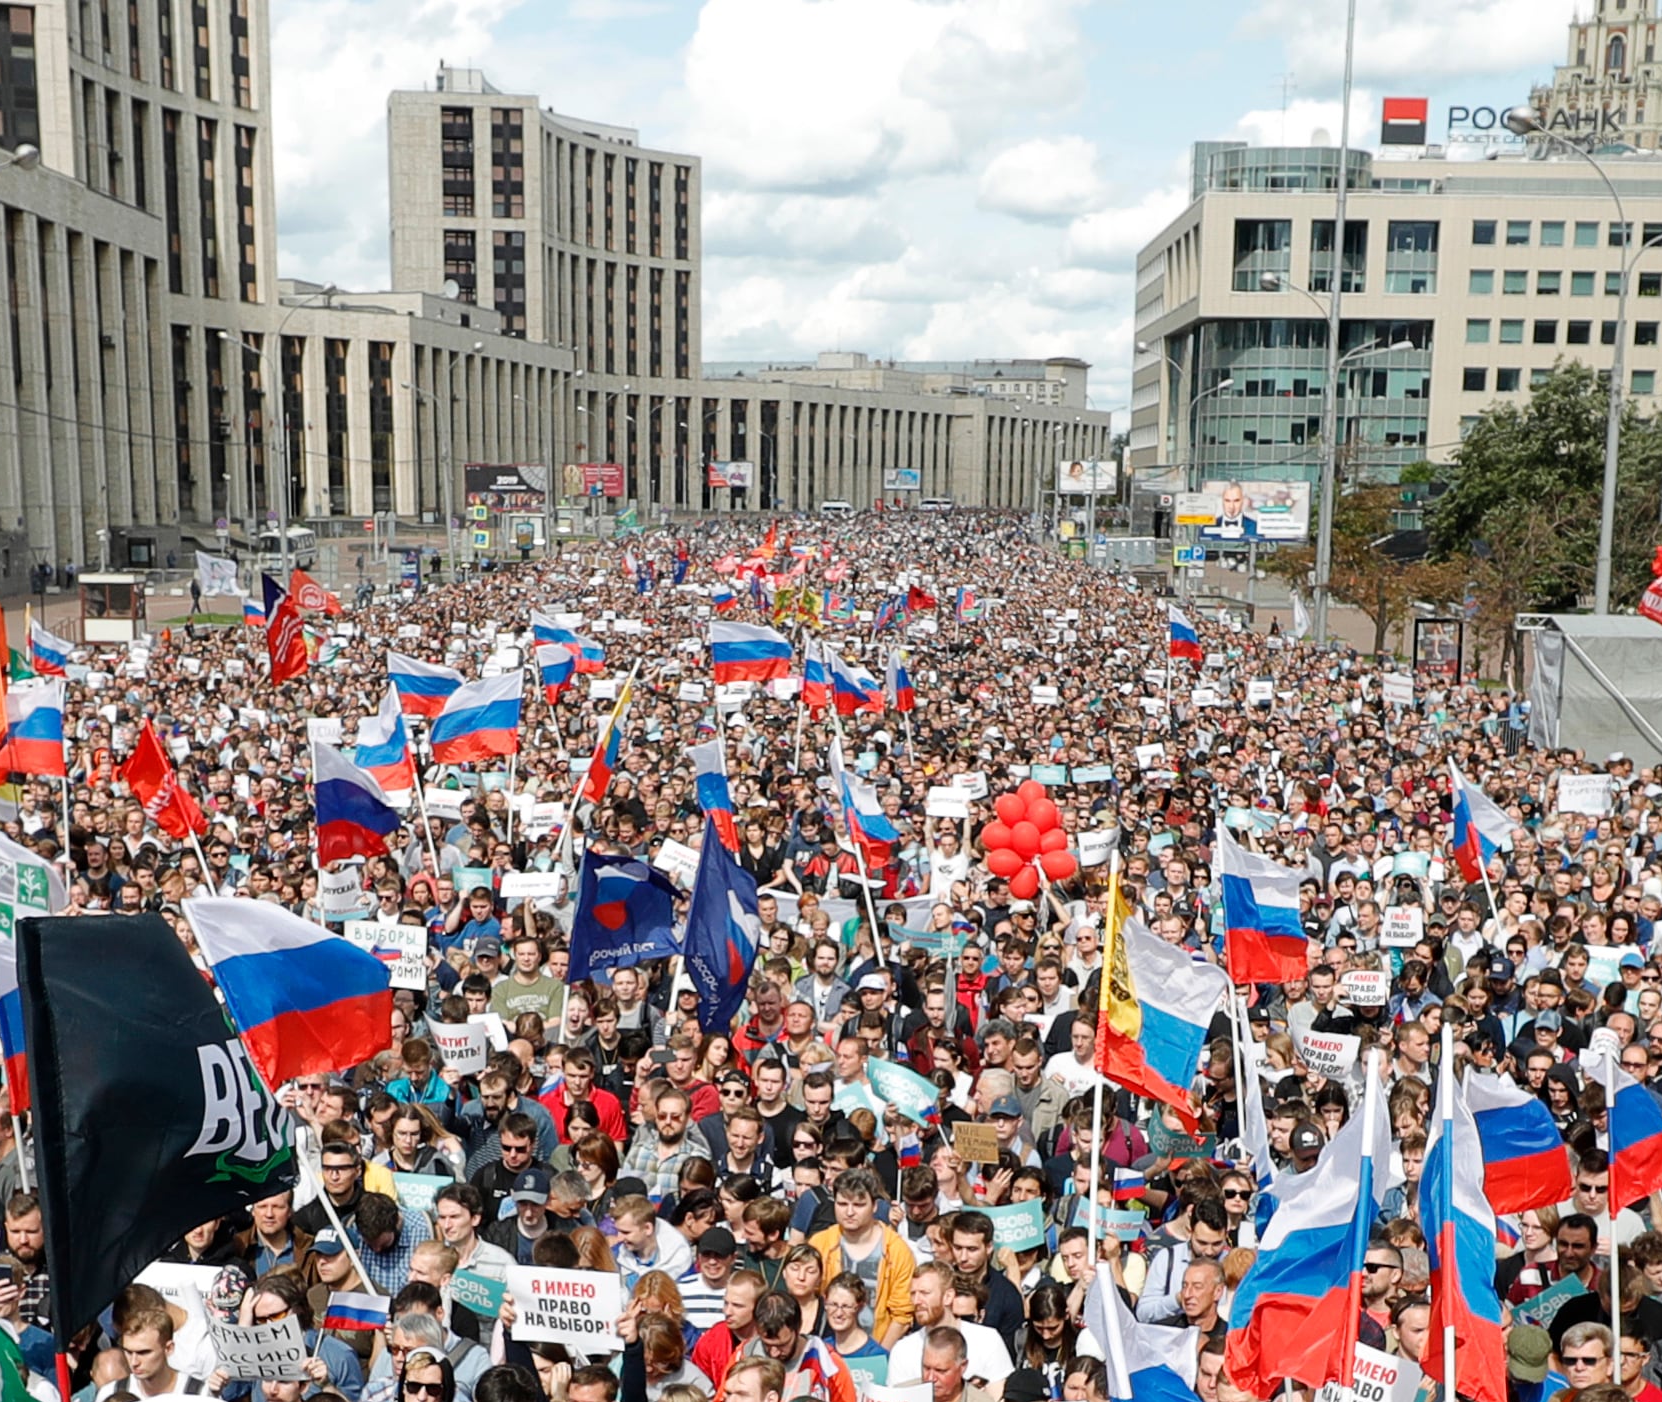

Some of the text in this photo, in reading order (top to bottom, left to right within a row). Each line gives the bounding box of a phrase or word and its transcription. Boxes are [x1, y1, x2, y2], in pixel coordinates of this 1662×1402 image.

[1312, 1038, 1343, 1052] ИМЕЮ
[1303, 1046, 1337, 1063] ПРАВО
[995, 1212, 1034, 1227] БОВЬ
[994, 1225, 1039, 1243] ОБОЛЬ
[531, 1280, 596, 1303] Я ИМЕЮ
[537, 1297, 592, 1317] ПРАВО
[524, 1310, 611, 1335] НА ВЫБОР!
